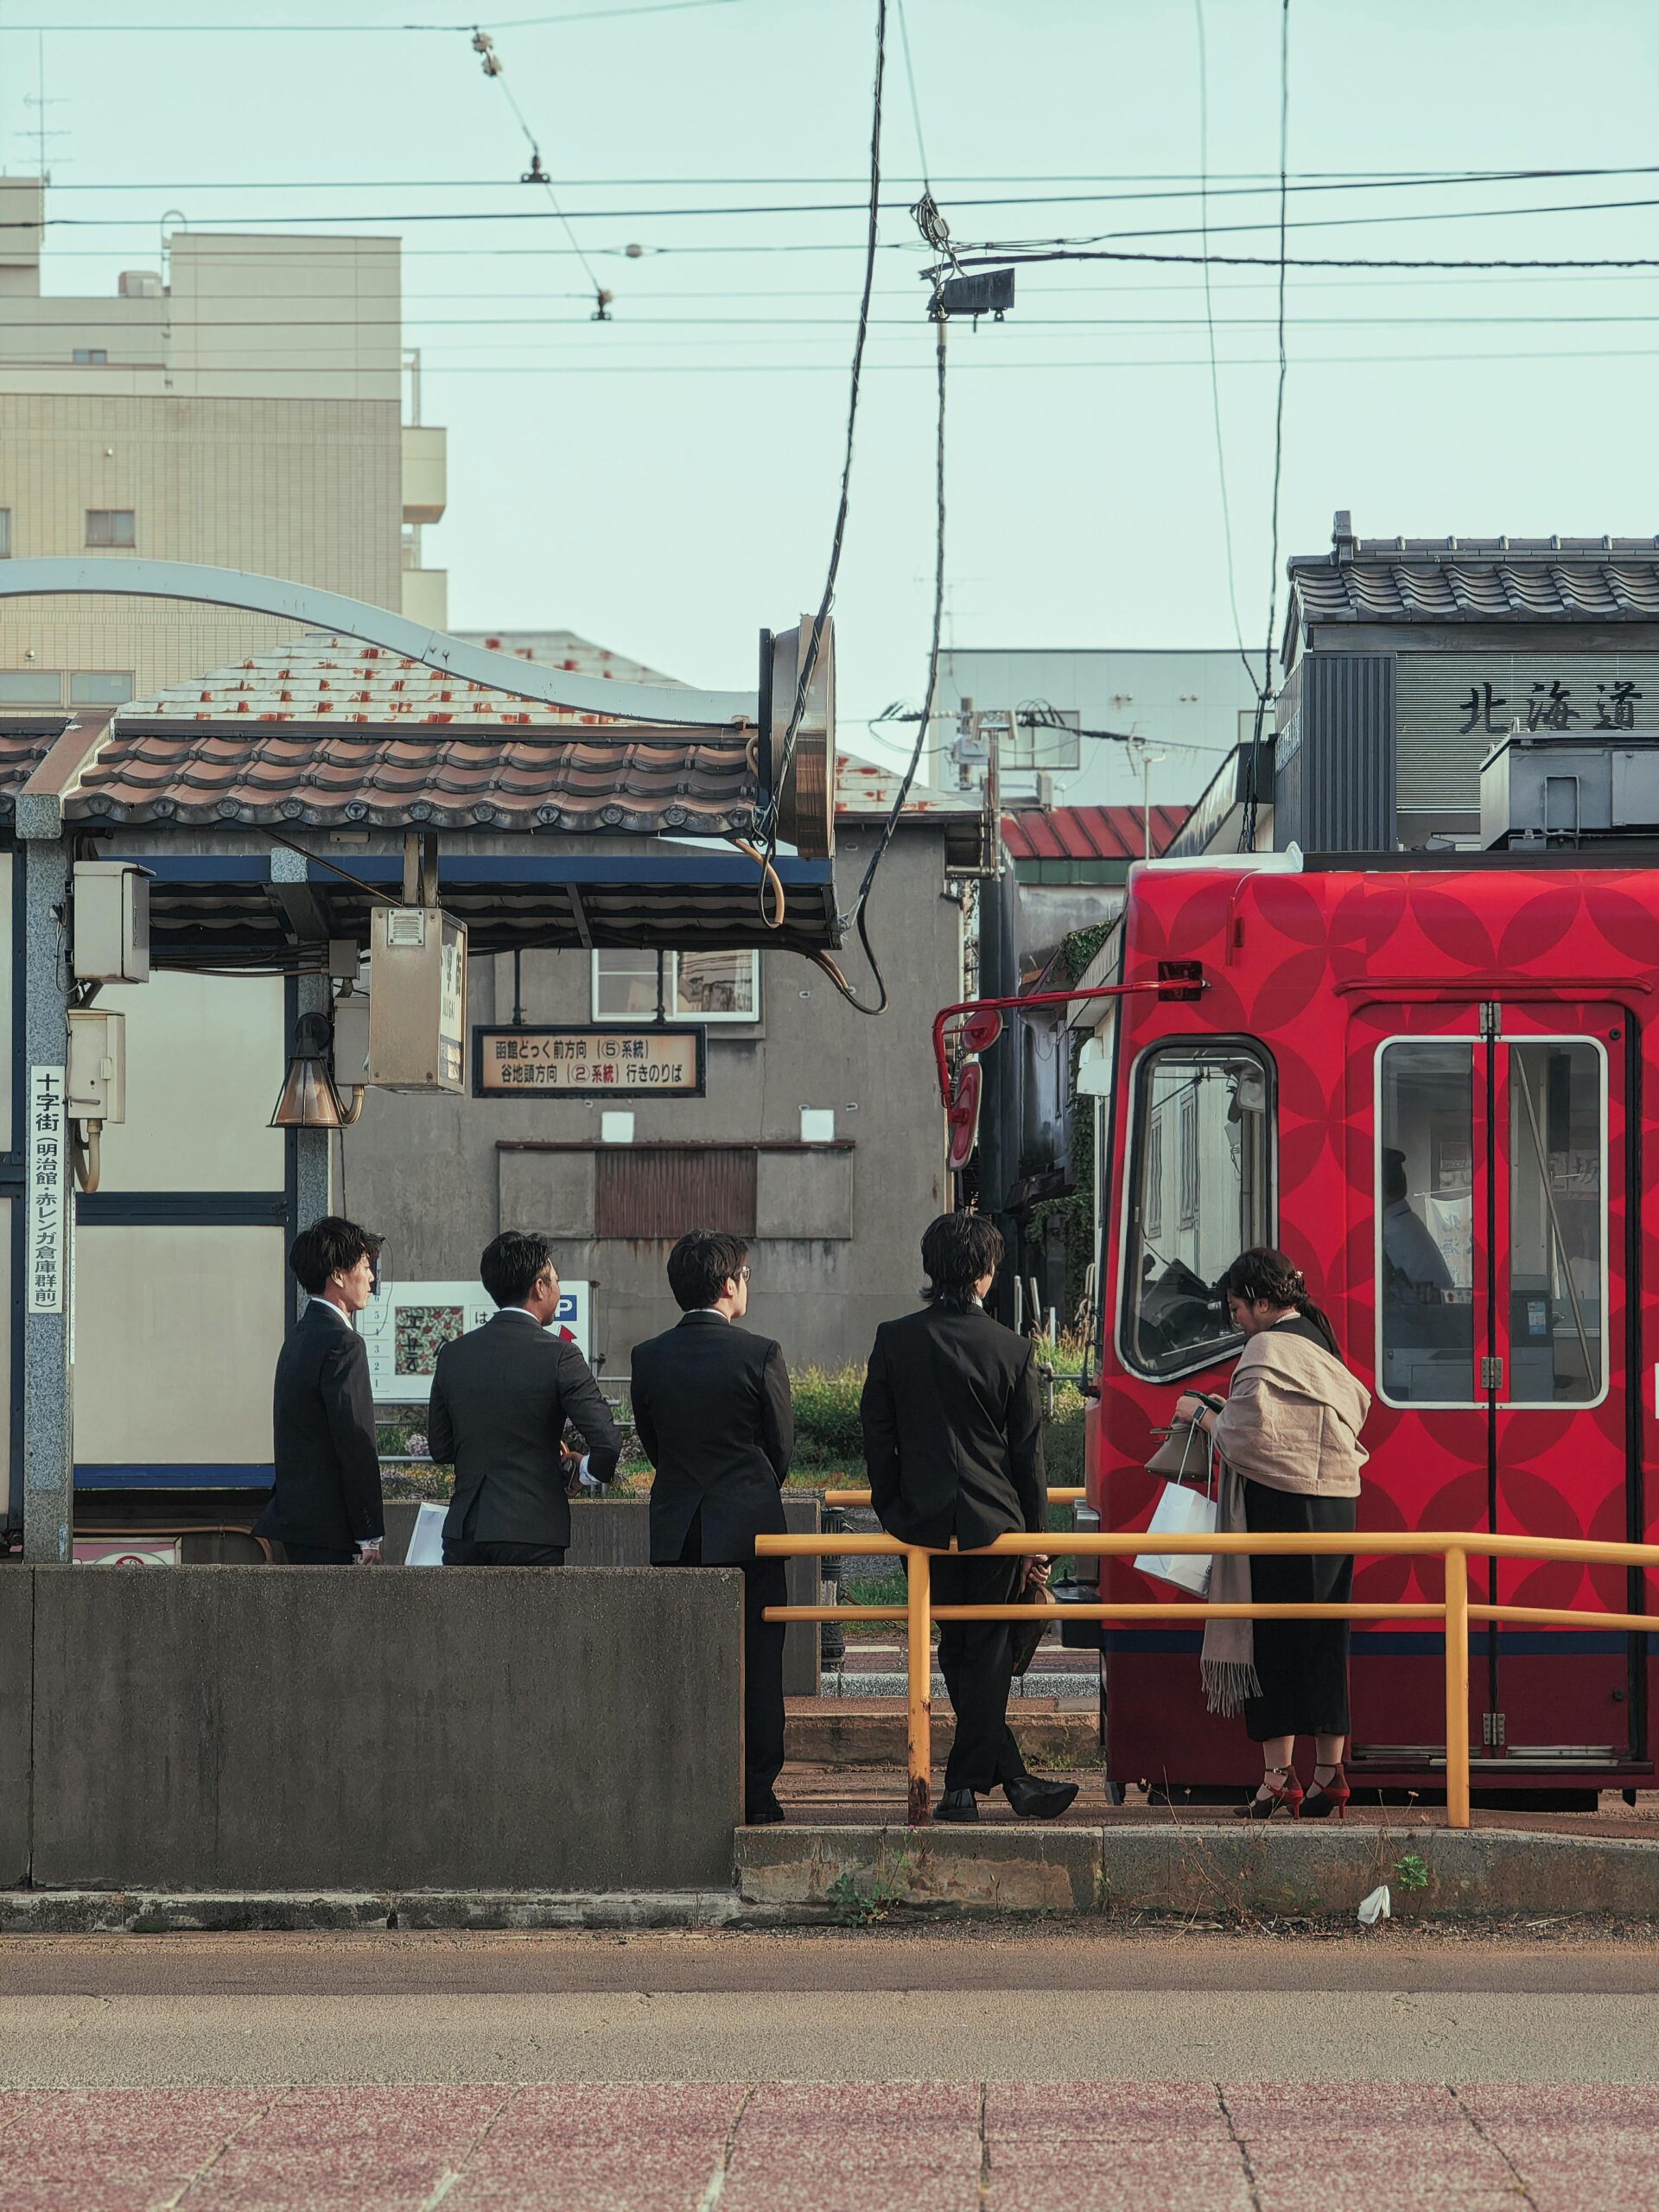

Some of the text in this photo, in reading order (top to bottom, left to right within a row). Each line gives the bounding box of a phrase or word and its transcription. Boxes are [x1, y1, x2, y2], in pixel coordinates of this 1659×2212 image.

[1459, 680, 1643, 734] 北海道
[374, 1311, 379, 1319] 5
[556, 1299, 573, 1318] P
[374, 1362, 379, 1370] 2
